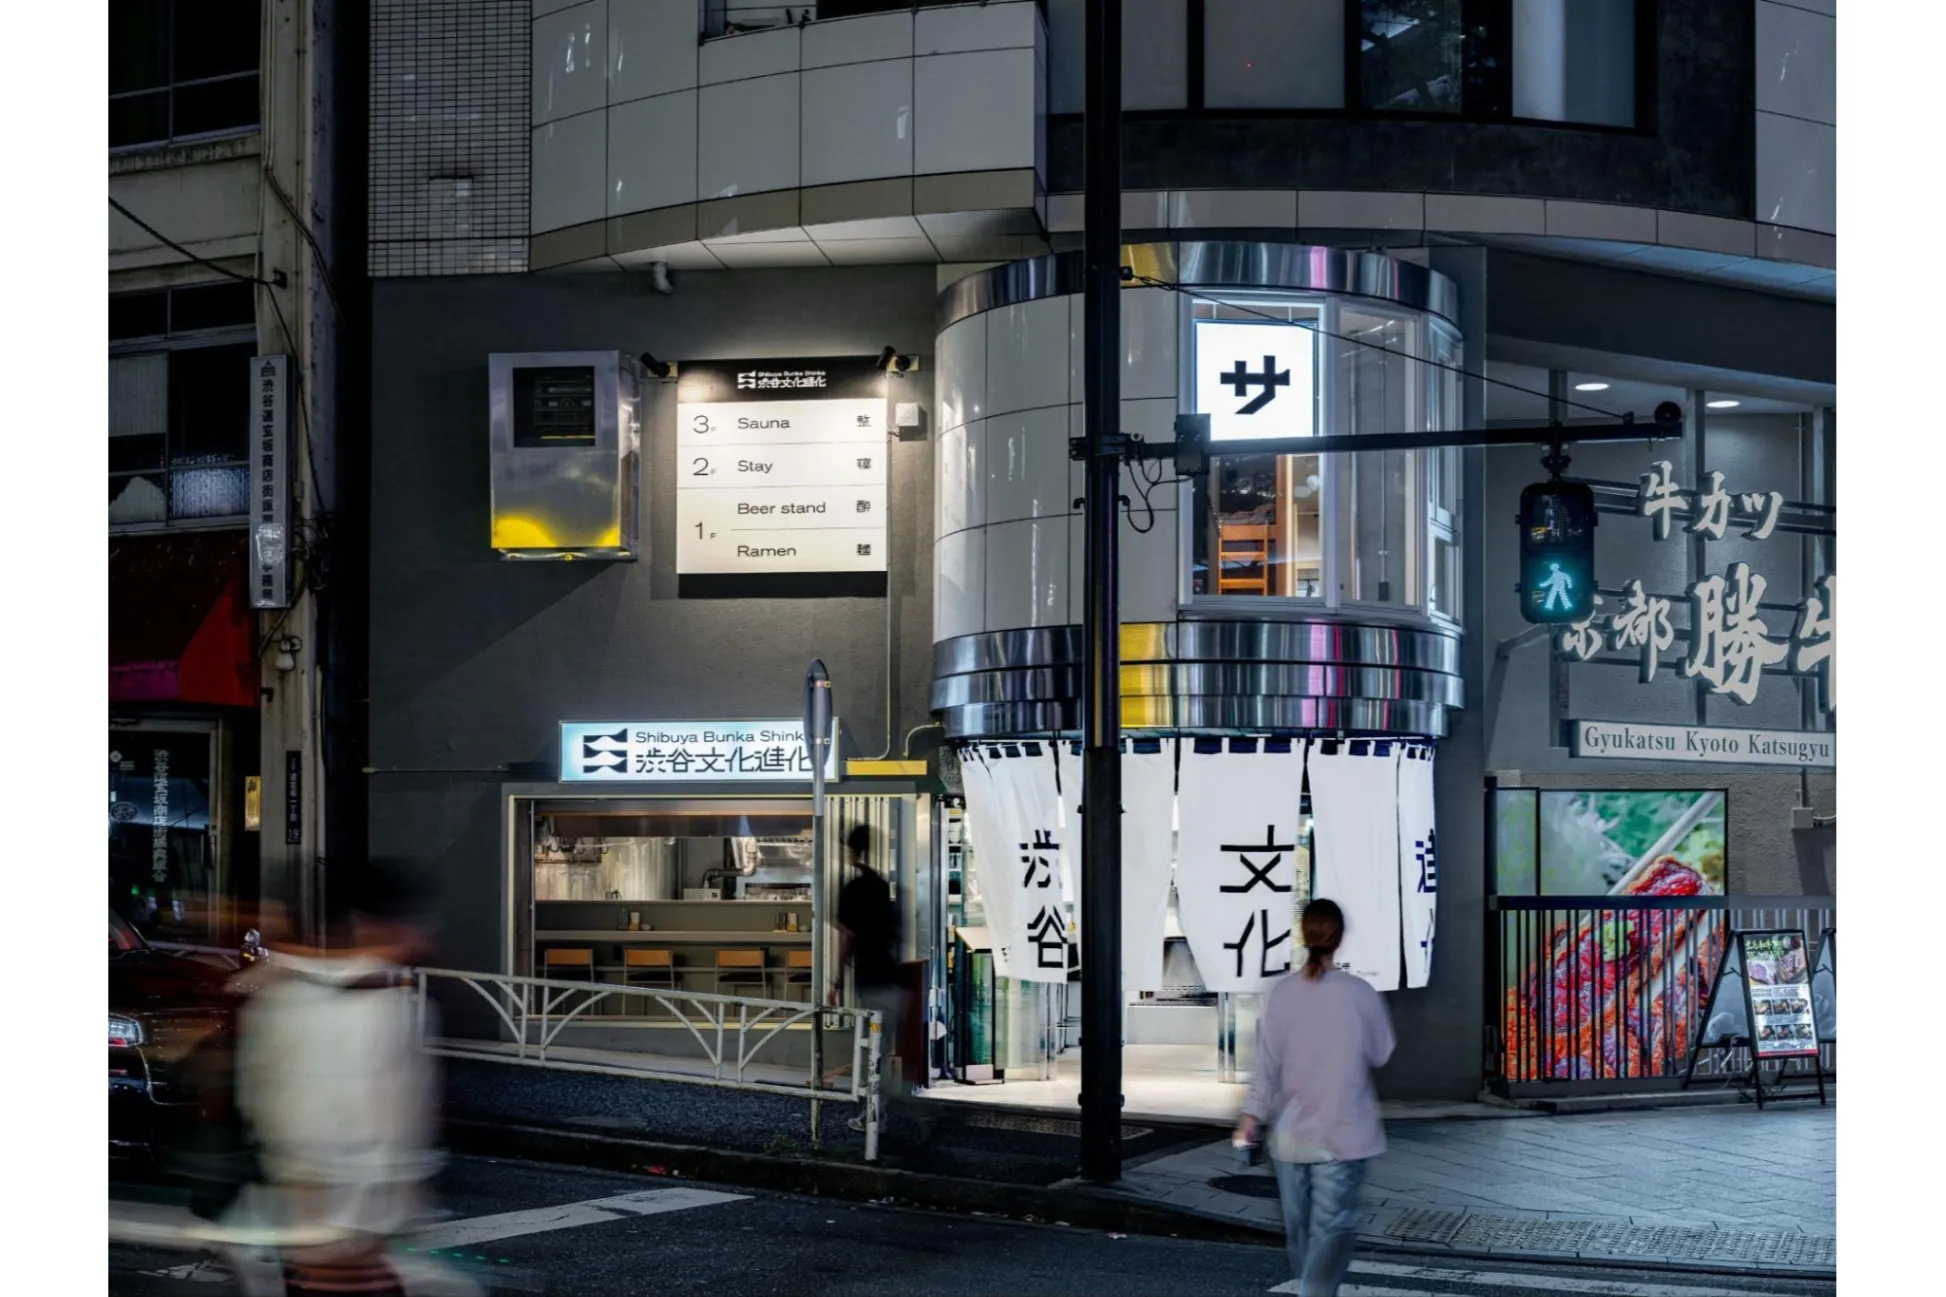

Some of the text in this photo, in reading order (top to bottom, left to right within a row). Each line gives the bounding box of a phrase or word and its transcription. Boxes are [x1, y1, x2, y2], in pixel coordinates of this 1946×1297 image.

[1219, 354, 1291, 415] サ
[737, 417, 791, 430] Sauna
[737, 459, 774, 475] Stay
[737, 501, 827, 515] Beer stand
[1643, 460, 1785, 542] 牛カツ
[737, 545, 797, 558] Ramen
[635, 730, 804, 746] Shibuya Bunka Shink
[1583, 726, 1832, 764] Gyukatsu Kyoto Katsugyu
[635, 746, 812, 774] 渋谷文化進化
[1219, 824, 1295, 978] 文化
